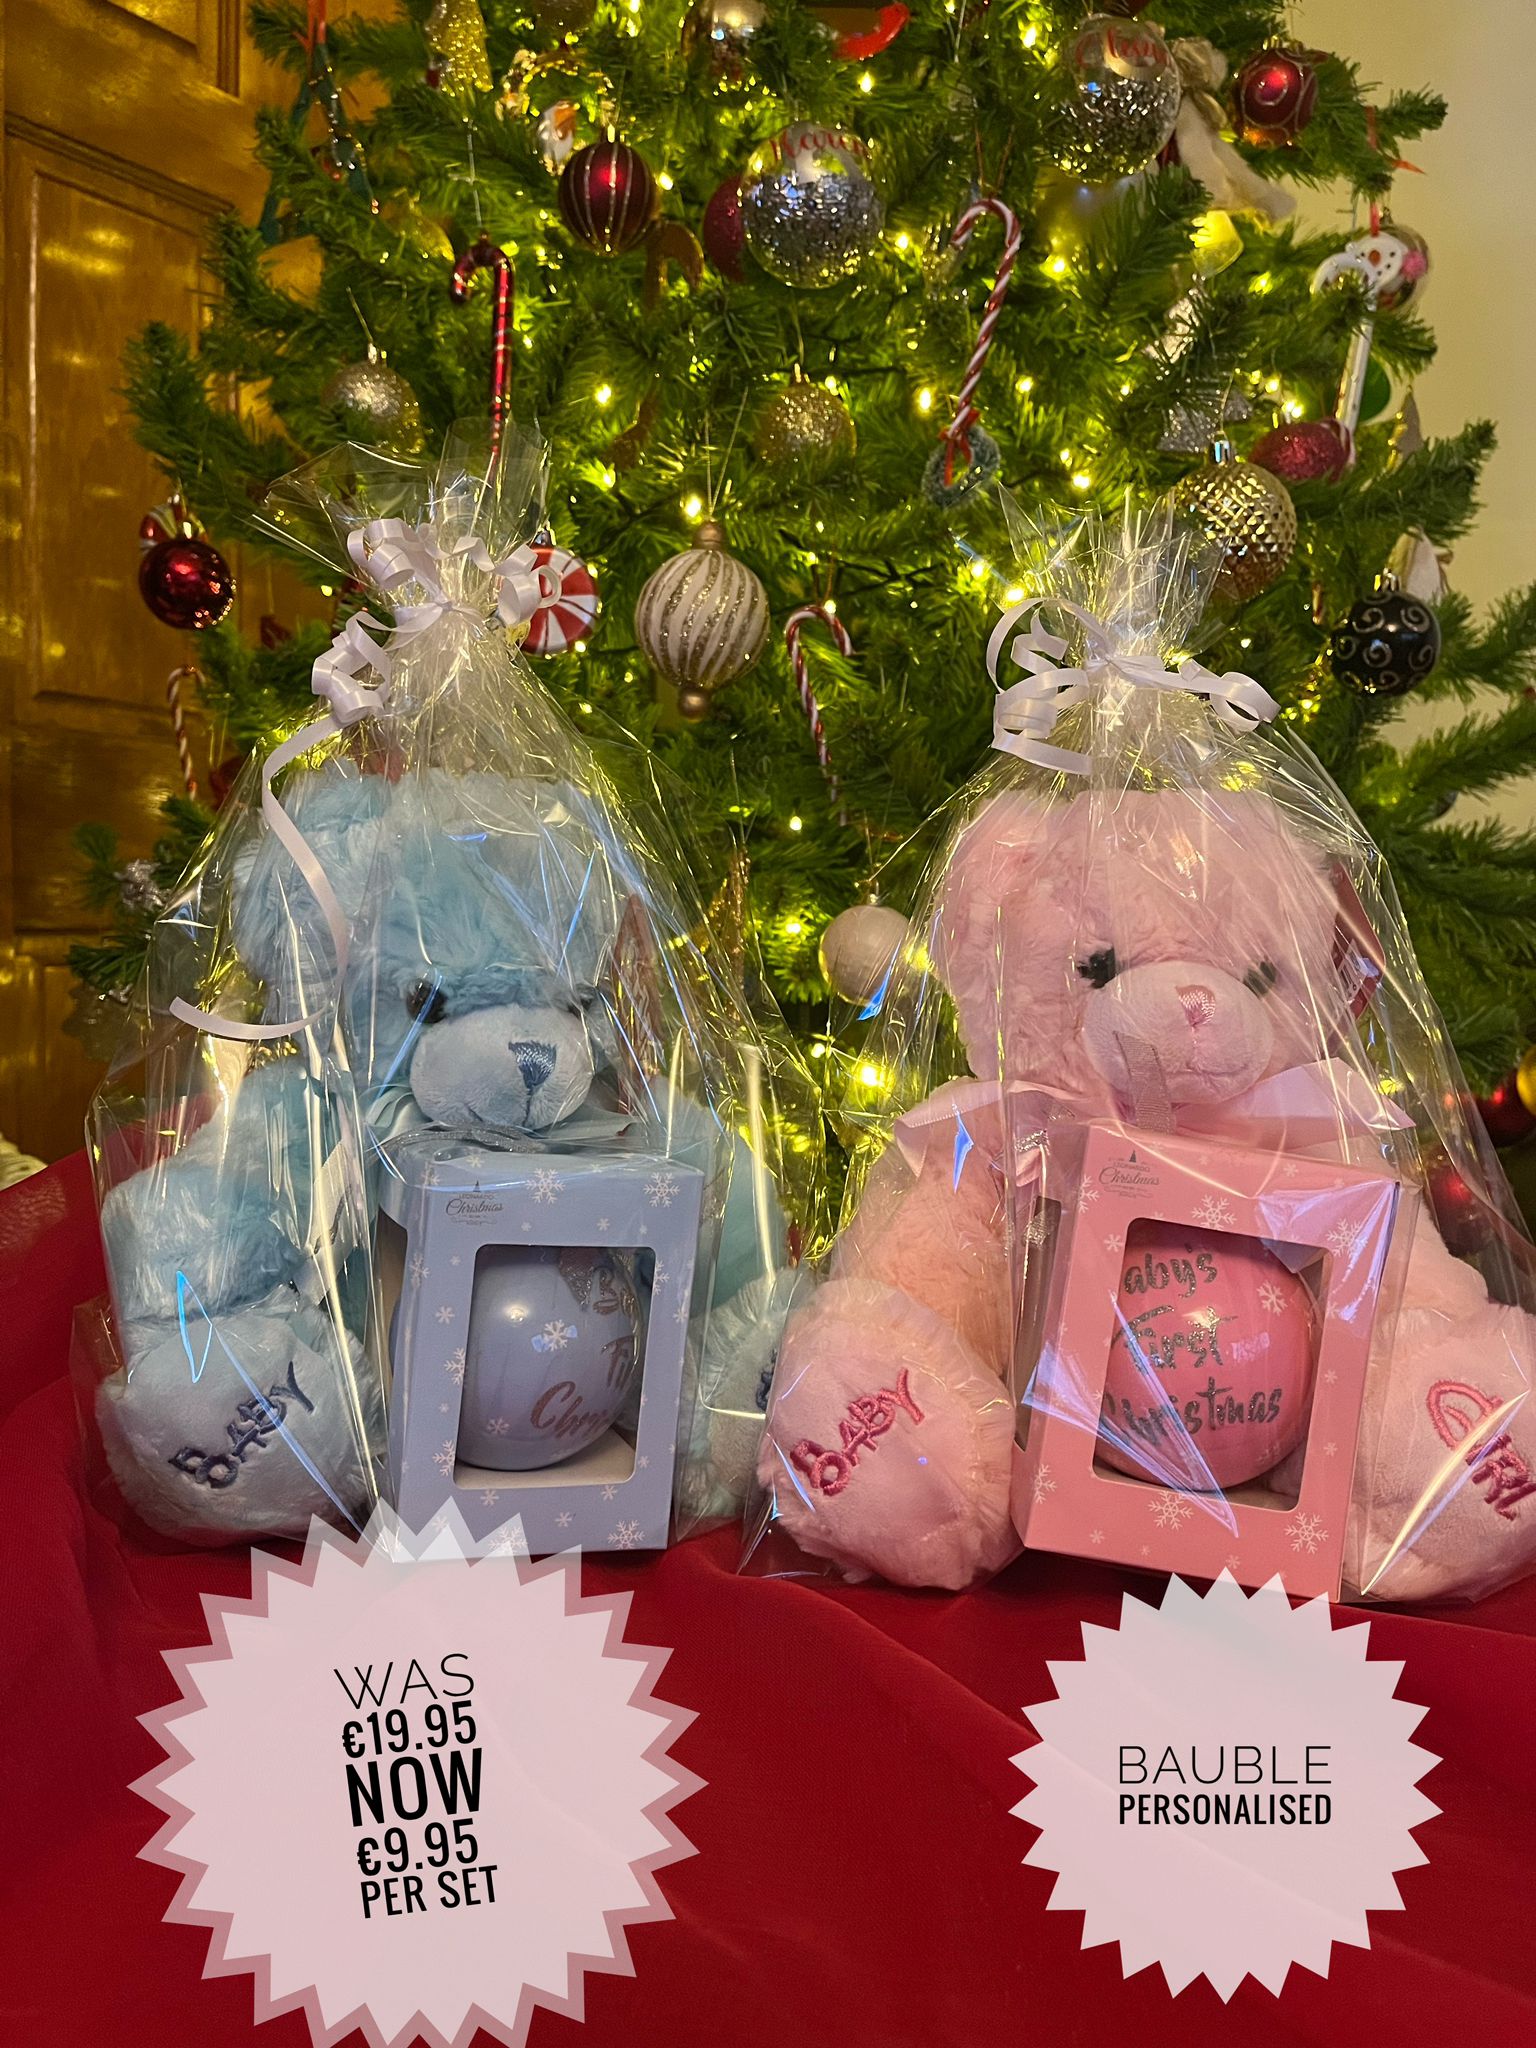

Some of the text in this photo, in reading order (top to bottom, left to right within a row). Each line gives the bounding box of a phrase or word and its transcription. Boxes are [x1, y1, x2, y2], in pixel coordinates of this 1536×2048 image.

[445, 1198, 504, 1216] Christmas
[1098, 1166, 1160, 1186] Christmas
[1112, 1304, 1239, 1376] First
[167, 1360, 315, 1488] BABY
[789, 1367, 925, 1496] BABY
